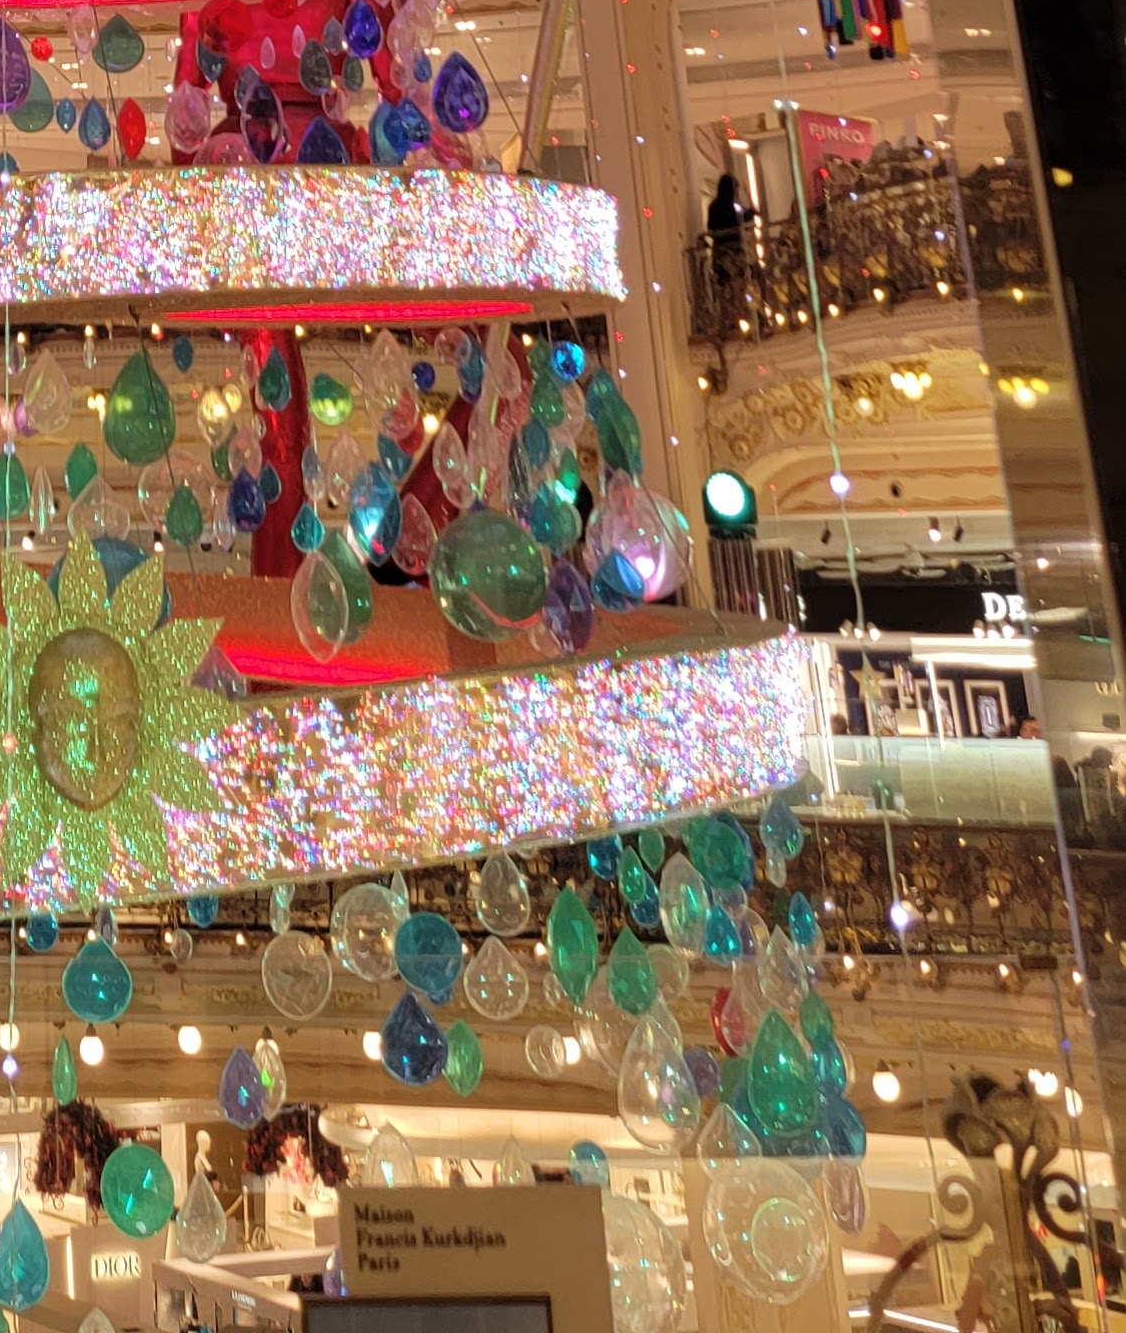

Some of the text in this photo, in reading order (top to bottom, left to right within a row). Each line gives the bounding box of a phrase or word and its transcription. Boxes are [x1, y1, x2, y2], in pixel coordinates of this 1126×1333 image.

[809, 122, 865, 144] PINKO
[354, 1203, 415, 1223] Maison
[356, 1225, 507, 1254] Francis Kurkdjian
[94, 1255, 141, 1280] DIOR
[358, 1251, 401, 1272] Paris
